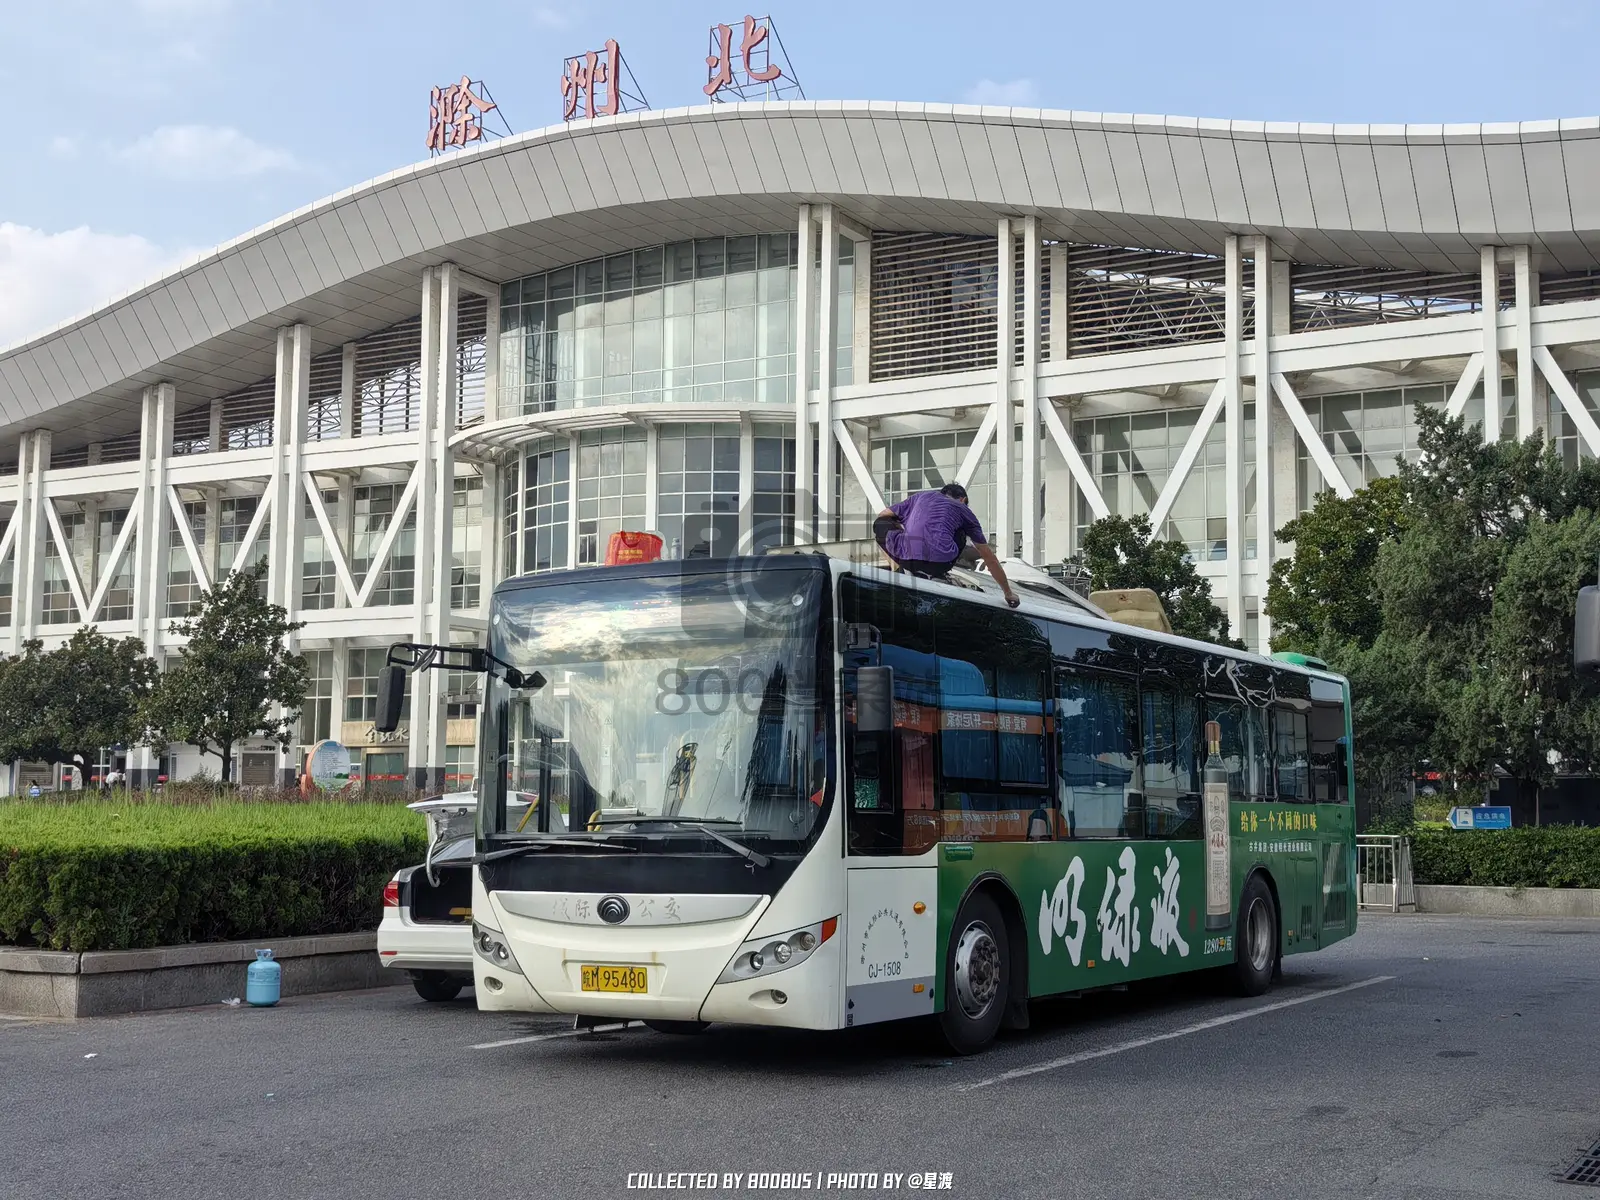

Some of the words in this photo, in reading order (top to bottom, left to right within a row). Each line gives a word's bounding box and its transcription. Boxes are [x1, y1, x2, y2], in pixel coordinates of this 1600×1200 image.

[426, 15, 781, 150] 滁州北
[1240, 810, 1318, 832] 给你一个不同的口味
[637, 897, 682, 921] 公交
[868, 961, 902, 979] CJ-1508
